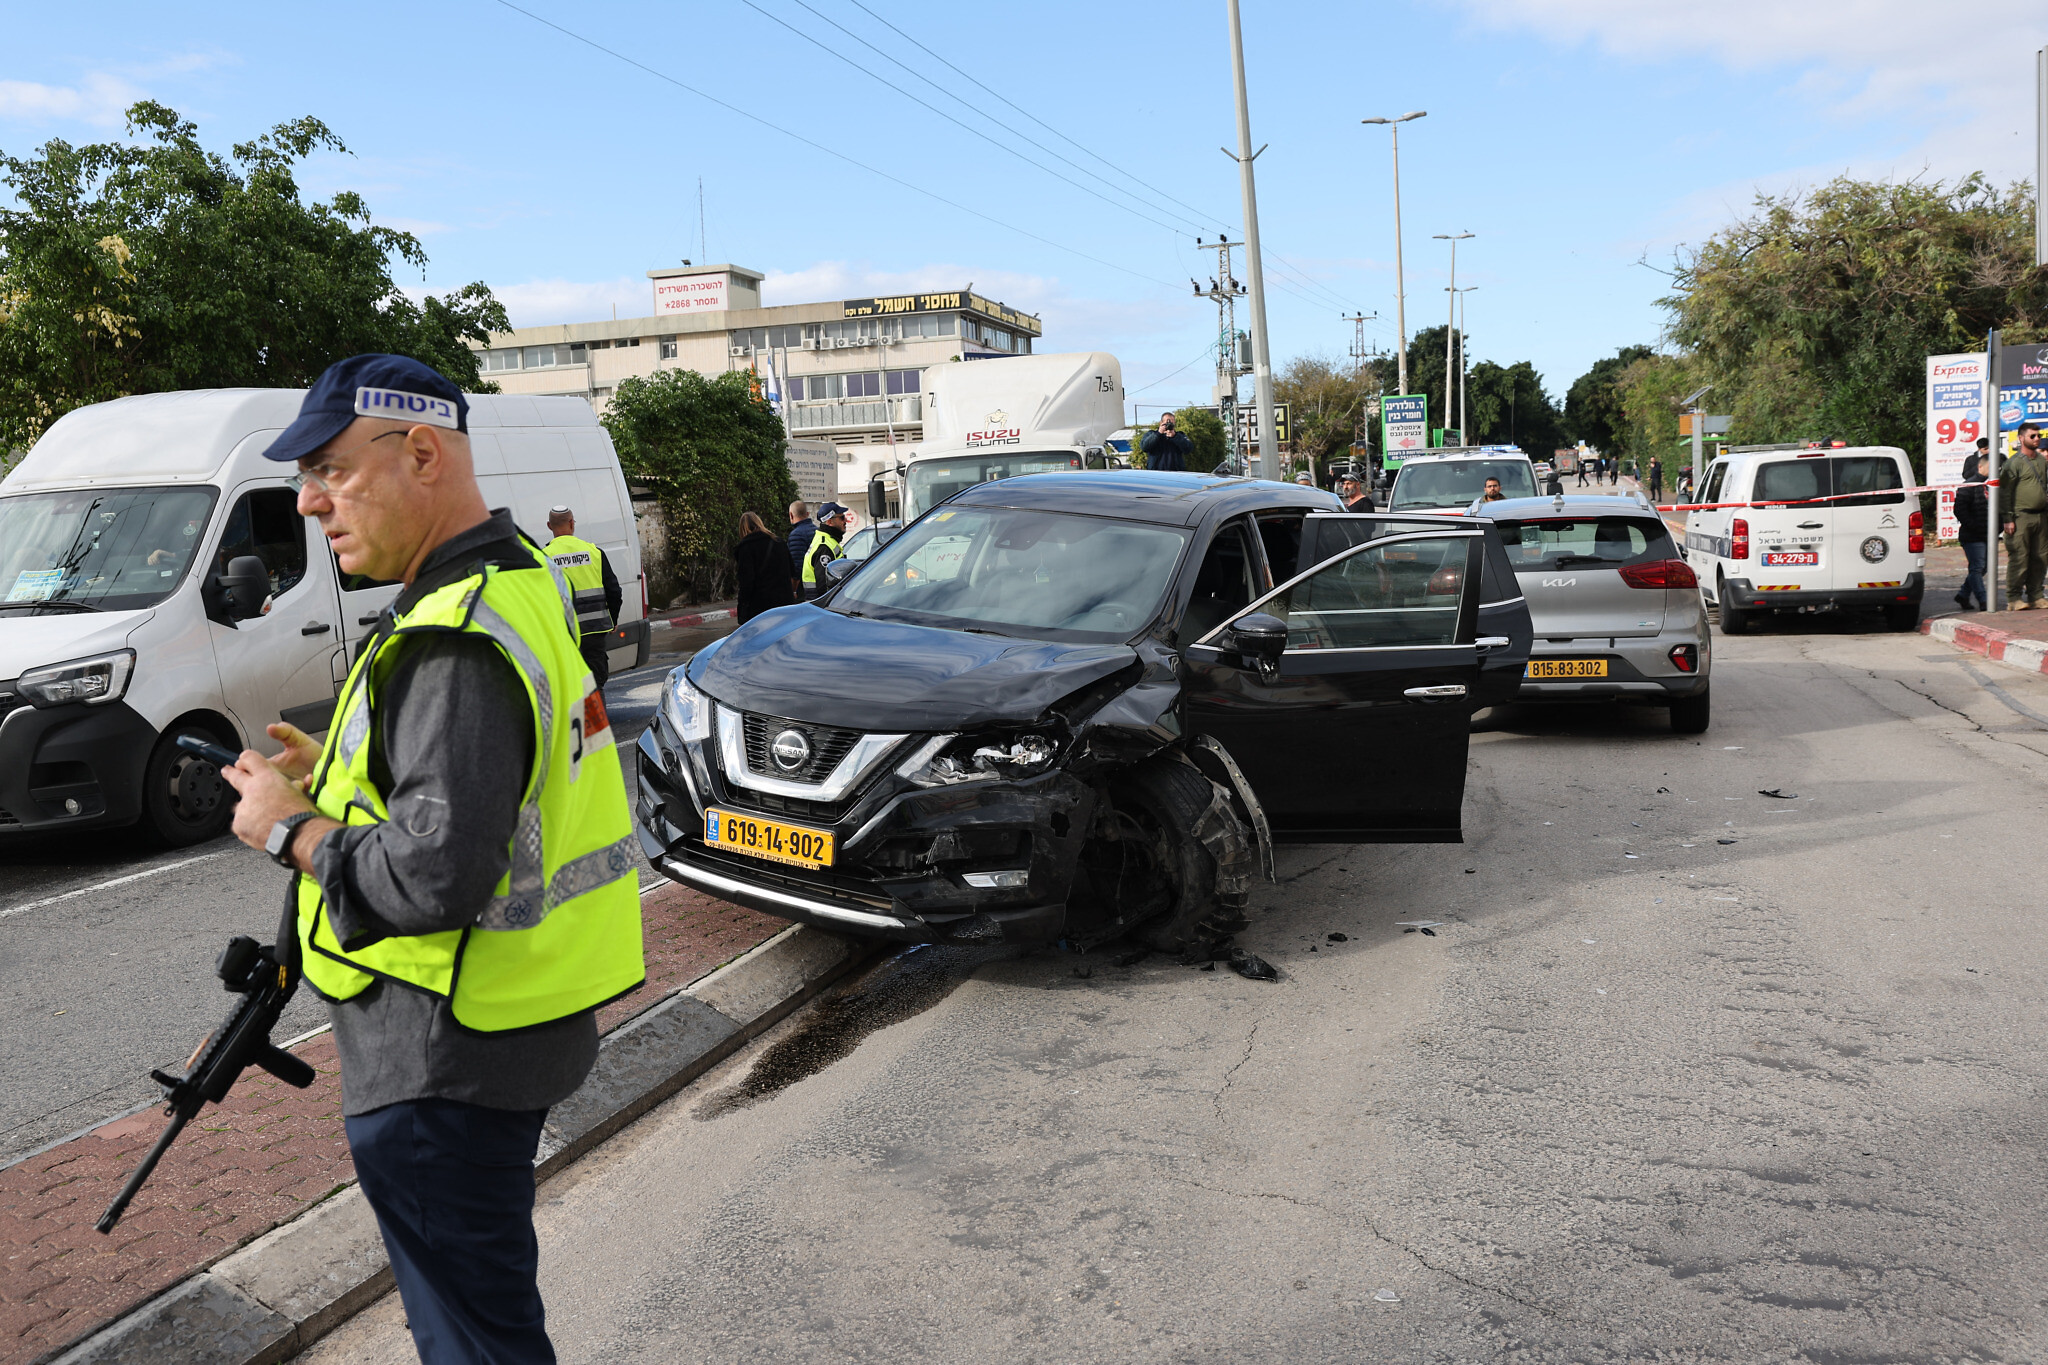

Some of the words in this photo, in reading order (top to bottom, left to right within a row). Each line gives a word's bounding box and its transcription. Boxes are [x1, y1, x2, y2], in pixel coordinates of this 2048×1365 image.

[658, 284, 689, 294] משרדים
[690, 280, 723, 291] להשכרה
[694, 297, 718, 306] ומסחר
[874, 296, 915, 314] חשמל
[921, 293, 961, 309] מחסני
[1933, 364, 1979, 379] Express
[2022, 363, 2043, 375] kw
[1934, 385, 1951, 393] רכב
[1952, 383, 1980, 392] שטיפת
[1999, 386, 2047, 402] גלידה
[362, 390, 452, 419] ביטחון
[1385, 400, 1415, 411] גולדרינג
[1962, 397, 1979, 406] ללא
[1388, 413, 1401, 422] בנין
[1402, 411, 1422, 420] חומרי
[966, 428, 1021, 441] ISUZU
[1936, 418, 1980, 445] 99
[966, 437, 1020, 448] SUMO
[1758, 537, 1786, 545] ישראל
[553, 556, 571, 566] עירוני
[571, 553, 590, 564] פיקוח
[1542, 578, 1576, 588] KIA
[774, 747, 805, 757] NISSAN
